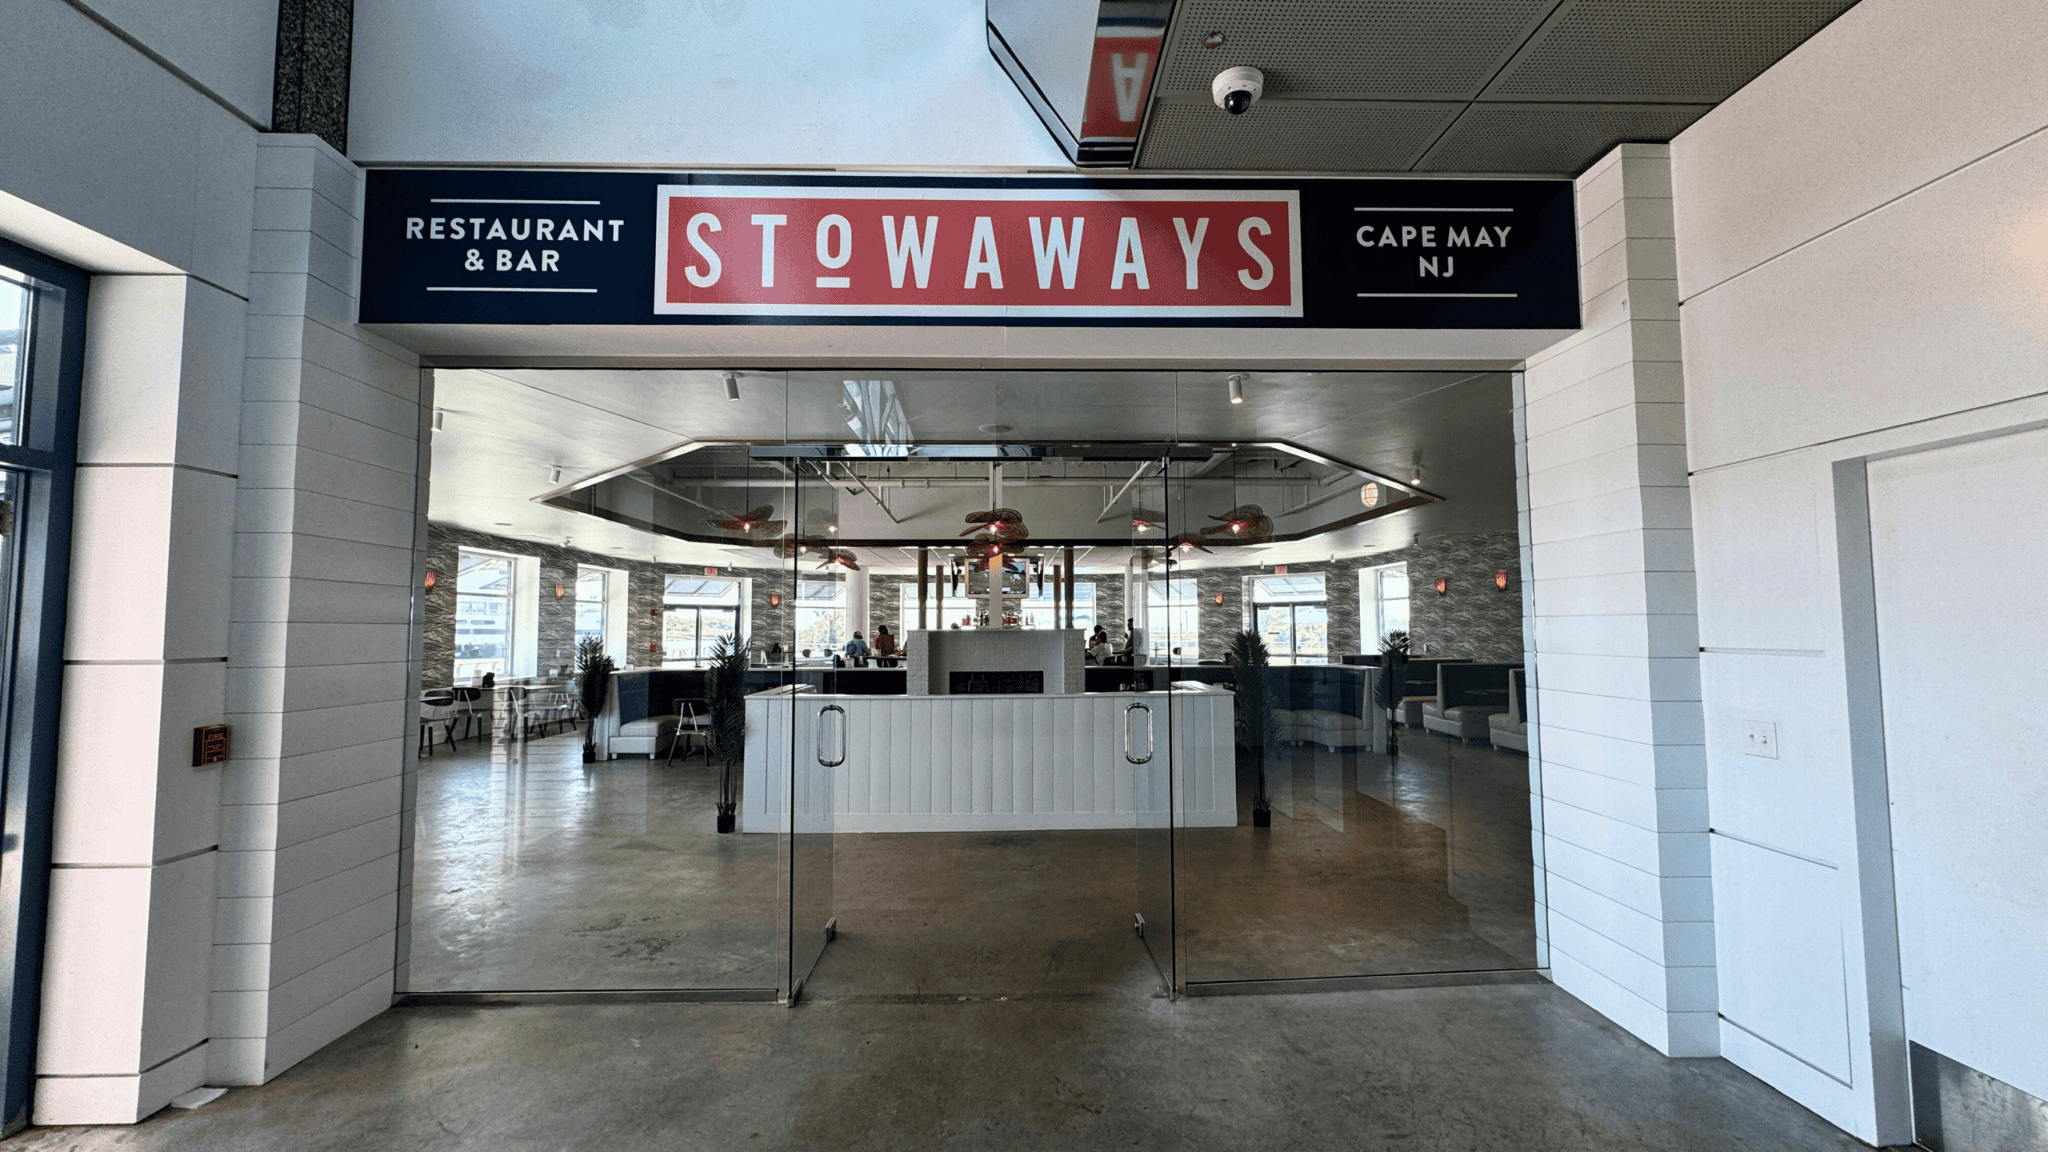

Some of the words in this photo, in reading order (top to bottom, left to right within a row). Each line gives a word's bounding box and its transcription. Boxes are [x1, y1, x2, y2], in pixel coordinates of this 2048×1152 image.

[406, 217, 625, 242] RESTAURANT
[1356, 225, 1437, 247] CAPE
[1447, 226, 1512, 248] MAY
[465, 248, 485, 272] &
[496, 249, 560, 272] BAR
[684, 212, 1275, 291] STOWAWAYS
[1420, 255, 1454, 278] NJ
